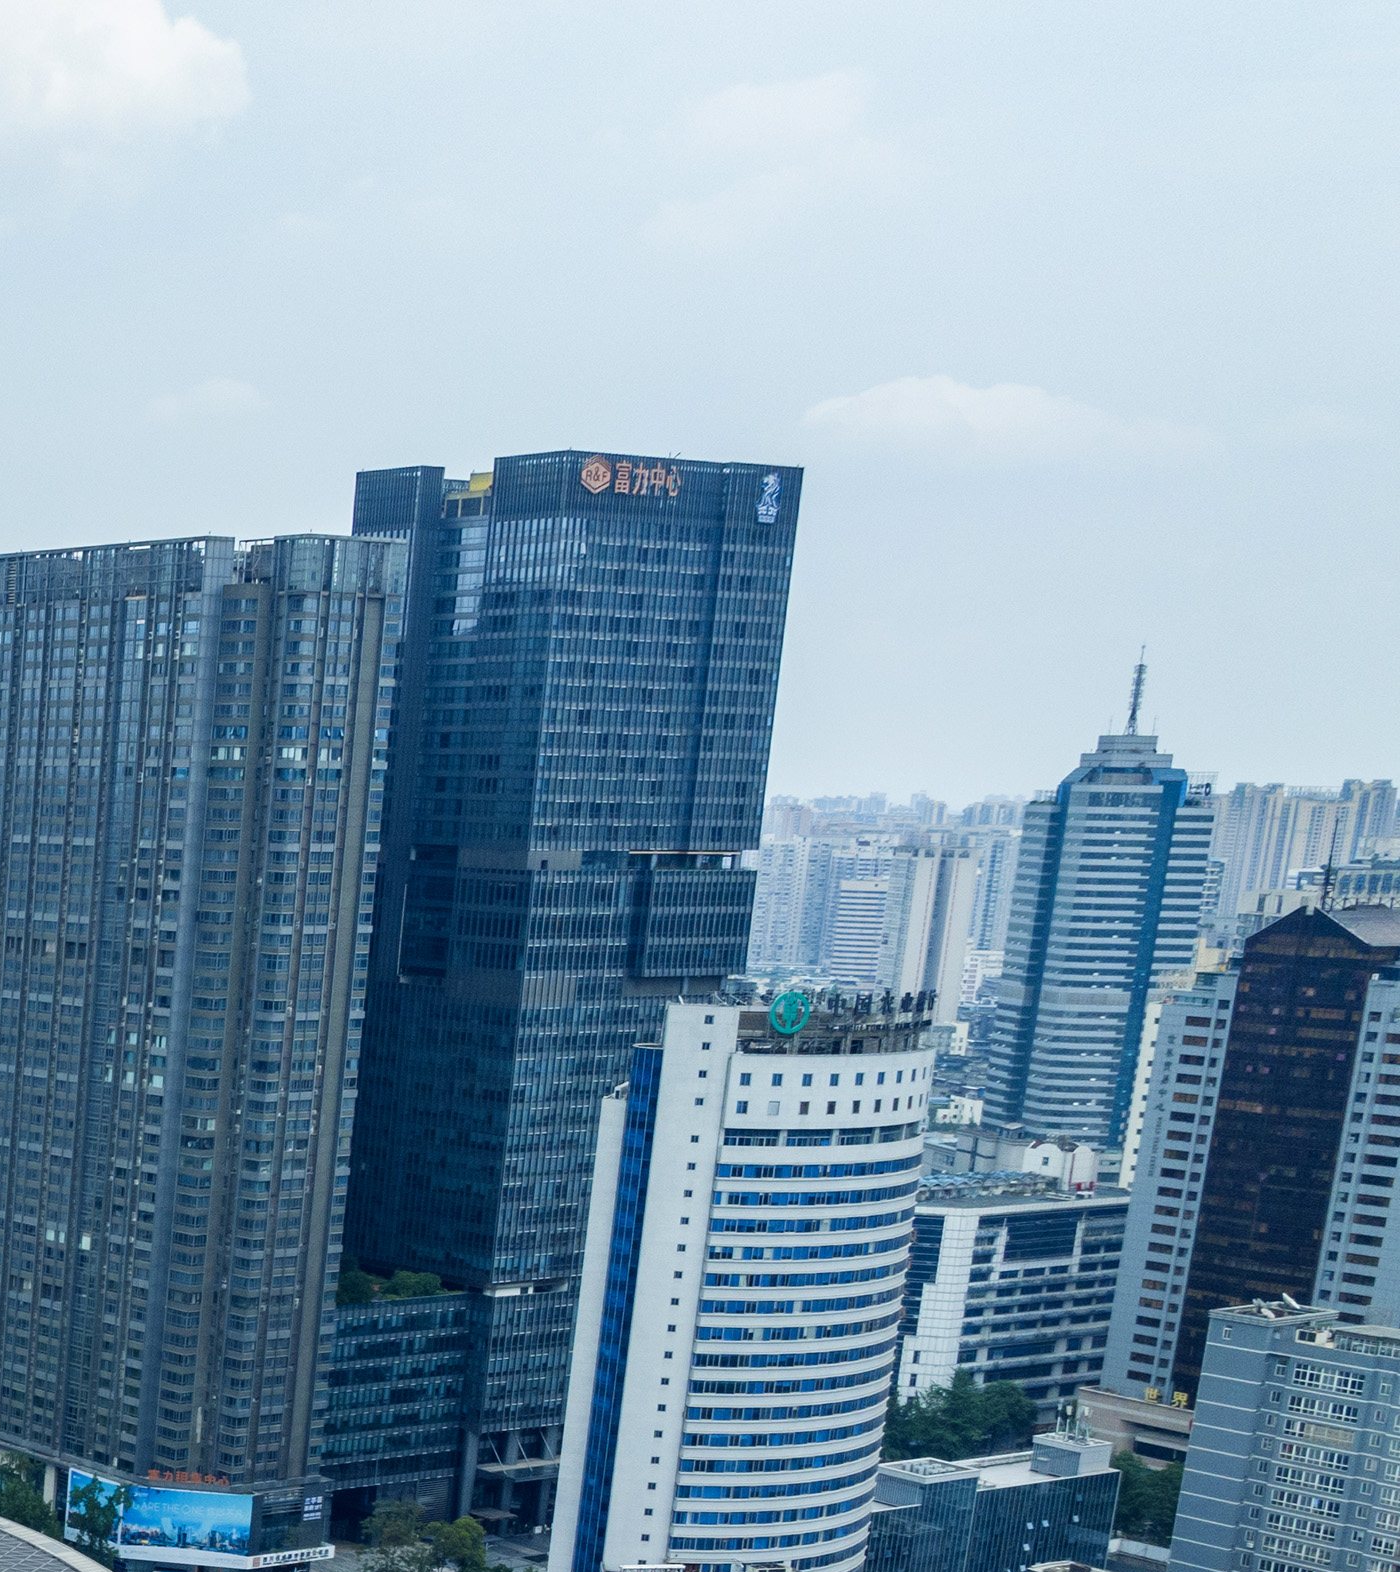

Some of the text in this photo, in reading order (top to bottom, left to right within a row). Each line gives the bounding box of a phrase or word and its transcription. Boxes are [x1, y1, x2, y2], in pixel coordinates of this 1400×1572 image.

[614, 460, 681, 496] 富力中心
[1144, 1387, 1188, 1409] 世界
